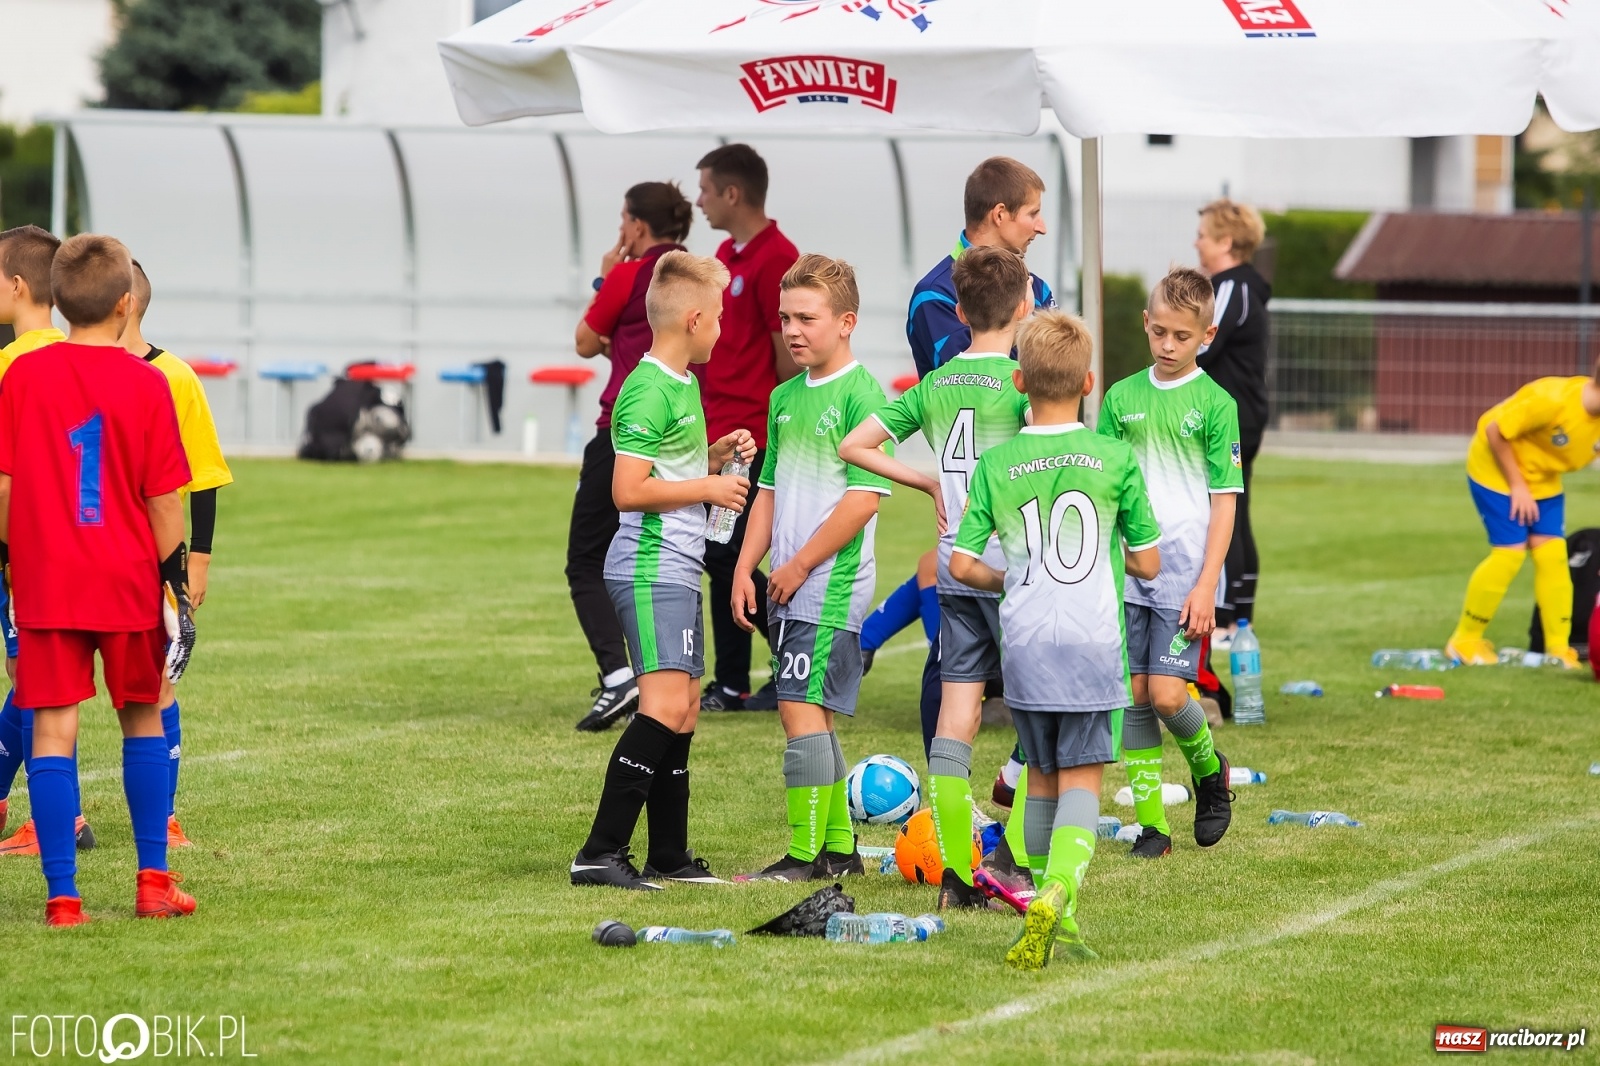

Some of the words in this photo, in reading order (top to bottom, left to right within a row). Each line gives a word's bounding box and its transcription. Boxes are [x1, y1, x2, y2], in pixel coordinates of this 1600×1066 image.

[754, 59, 876, 93] ŻYWIEC
[66, 411, 104, 526] 1
[942, 407, 980, 493] 4
[1008, 453, 1104, 481] ŻYWIECCZYZNA
[1017, 489, 1100, 586] 10
[682, 629, 694, 656] 15
[781, 651, 811, 680] 20
[929, 776, 947, 862] ŻYWIECCZYZNA
